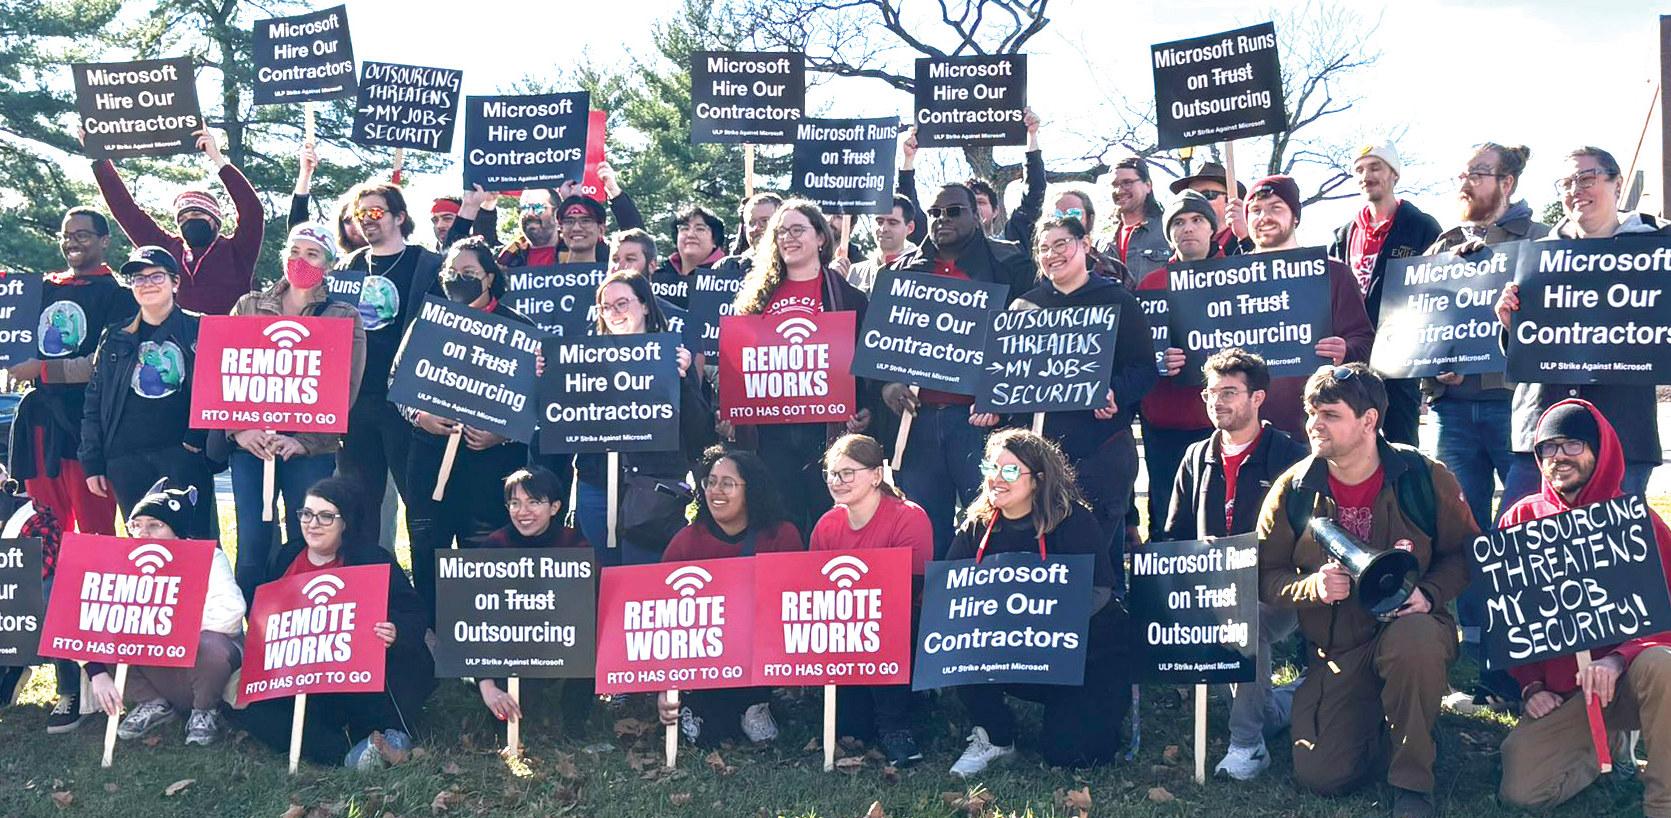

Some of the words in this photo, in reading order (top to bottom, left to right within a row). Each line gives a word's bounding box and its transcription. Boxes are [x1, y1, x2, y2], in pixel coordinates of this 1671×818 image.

[268, 14, 340, 39] Microsoft
[274, 44, 309, 60] Hire
[312, 39, 338, 56] Our
[1154, 38, 1234, 69] Microsoft
[1237, 33, 1275, 54] Runs
[86, 64, 178, 86] Microsoft
[258, 60, 353, 82] Contractors
[365, 64, 460, 92] OUTSOURCING
[706, 57, 791, 74] Microsoft
[928, 61, 1012, 78] Microsoft
[1187, 73, 1208, 90] on
[1211, 62, 1254, 86] Trust
[96, 92, 132, 110] Hire
[138, 90, 175, 108] Our
[366, 84, 451, 109] THREATENS
[712, 80, 748, 97] Hire
[752, 80, 786, 98] Our
[934, 84, 969, 101] Hire
[972, 84, 1007, 100] Our
[376, 104, 403, 122] MY
[402, 108, 436, 126] JOB
[482, 98, 573, 118] Microsoft
[696, 102, 802, 121] Contractors
[918, 106, 1022, 124] Contractors
[1171, 90, 1271, 120] Outsourcing
[84, 114, 198, 134] Contractors
[364, 122, 443, 149] SECURITY
[488, 125, 528, 142] Hire
[532, 124, 567, 140] Our
[796, 124, 864, 142] Microsoft
[868, 125, 898, 140] Runs
[469, 146, 581, 166] Contractors
[821, 150, 839, 165] on
[842, 148, 876, 166] Trust
[581, 186, 597, 195] GO
[804, 172, 885, 191] Outsourcing
[1404, 252, 1508, 286] Microsoft
[1540, 248, 1671, 273] Microsoft
[510, 269, 605, 292] Microsoft
[1170, 262, 1266, 292] Microsoft
[1272, 258, 1326, 280] Runs
[516, 298, 554, 315] Hire
[890, 278, 988, 310] Microsoft
[1207, 300, 1232, 318] on
[1236, 290, 1290, 316] Trust
[1407, 294, 1449, 314] Hire
[1455, 287, 1498, 308] Our
[1544, 285, 1598, 309] Hire
[1607, 283, 1662, 308] Our
[420, 301, 508, 345] Microsoft
[888, 304, 932, 328] Hire
[936, 312, 976, 336] Our
[992, 306, 1116, 331] OUTSOURCING
[864, 329, 984, 366] Contractors
[996, 332, 1102, 356] THREATENS
[1188, 320, 1312, 352] Outsourcing
[221, 348, 321, 376] REMOTE
[442, 340, 467, 360] on
[470, 344, 518, 378] Trust
[560, 342, 661, 364] Microsoft
[742, 342, 830, 372] REMOTE
[1266, 356, 1302, 366] Microsoft
[1004, 360, 1032, 378] MY
[1036, 358, 1080, 378] JOB
[1540, 362, 1558, 370] ULP
[1558, 361, 1580, 370] Strike
[1582, 362, 1612, 372] Against
[1613, 362, 1652, 372] Microsoft
[222, 376, 318, 405] WORKS
[414, 358, 527, 412] Outsourcing
[565, 372, 608, 393] Hire
[613, 371, 654, 392] Our
[743, 370, 828, 399] WORKS
[990, 381, 1100, 406] SECURITY
[200, 410, 230, 422] RTO
[232, 410, 260, 422] HAS
[262, 411, 292, 424] GOT
[293, 412, 312, 424] TO
[315, 412, 336, 425] GO
[545, 402, 674, 422] Contractors
[730, 405, 754, 418] RTO
[756, 404, 780, 417] HAS
[782, 404, 807, 416] GOT
[808, 403, 826, 416] TO
[827, 402, 846, 415] GO
[1473, 496, 1647, 562] OUTSOURCING
[438, 556, 535, 579] Microsoft
[540, 556, 592, 579] Runs
[1134, 552, 1223, 576] Microsoft
[1226, 546, 1258, 570] Runs
[1482, 524, 1648, 592] THREATENS
[80, 570, 181, 605] REMOTE
[946, 564, 1069, 590] Microsoft
[474, 591, 500, 610] on
[504, 589, 556, 611] Trust
[781, 588, 882, 621] REMOTE
[948, 595, 998, 620] Hire
[1006, 592, 1058, 616] Our
[1168, 590, 1191, 610] on
[1195, 582, 1237, 608] Trust
[1486, 590, 1526, 632] MY
[1540, 578, 1608, 618] JOB
[79, 602, 174, 636] WORKS
[264, 600, 357, 642] REMOTE
[624, 595, 726, 630] REMOTE
[454, 620, 576, 648] Outsourcing
[783, 620, 880, 654] WORKS
[1147, 619, 1248, 648] Outsourcing
[1508, 593, 1652, 659] SECURITY!
[52, 637, 83, 652] RTO
[86, 640, 116, 656] HAS
[117, 642, 144, 656] GOT
[144, 644, 164, 658] TO
[166, 644, 186, 658] GO
[263, 632, 352, 672] WORKS
[626, 626, 724, 662] WORKS
[924, 626, 1080, 654] Contractors
[465, 658, 482, 666] ULP
[482, 658, 502, 666] Strike
[502, 658, 530, 668] Against
[530, 658, 564, 666] Microsoft
[607, 671, 636, 684] RTO
[638, 670, 666, 684] HAS
[668, 668, 698, 682] GOT
[699, 667, 720, 680] TO
[721, 666, 744, 679] GO
[764, 662, 792, 676] RTO
[794, 662, 824, 676] HAS
[826, 662, 856, 676] GOT
[857, 662, 878, 676] TO
[878, 661, 899, 676] GO
[942, 666, 958, 674] ULP
[958, 664, 980, 674] Strike
[980, 662, 1010, 674] Against
[1010, 661, 1050, 672] Microsoft
[1173, 663, 1193, 672] Strike
[1194, 662, 1216, 672] Against
[1216, 662, 1240, 670] Microsoft
[245, 678, 268, 694] RTO
[269, 675, 294, 691] HAS
[295, 672, 322, 688] GOT
[324, 671, 346, 686] TO
[348, 670, 372, 684] GO
